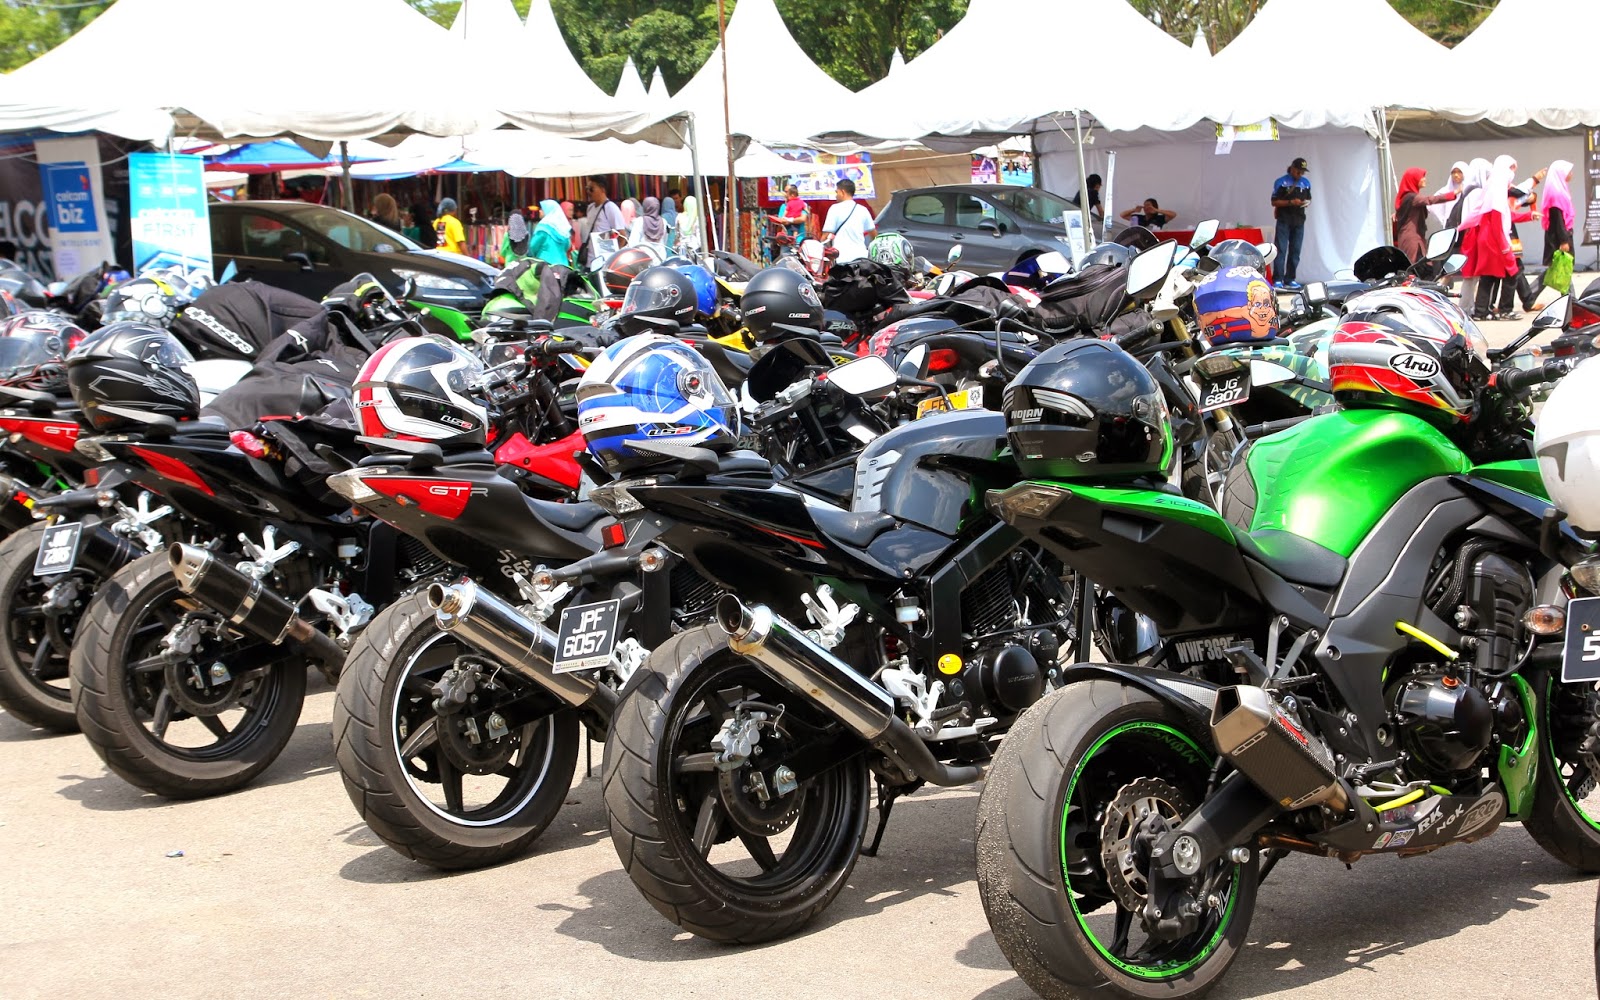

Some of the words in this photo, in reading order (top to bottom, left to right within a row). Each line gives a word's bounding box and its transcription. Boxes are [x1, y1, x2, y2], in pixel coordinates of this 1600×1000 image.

[58, 204, 85, 225] biz
[143, 222, 198, 237] FIRST
[184, 306, 254, 354] alpinestars
[1393, 355, 1434, 373] Arai
[1211, 378, 1238, 394] AJG
[1205, 387, 1243, 406] 6807
[440, 414, 473, 430] LS2
[1011, 408, 1044, 423] NOLAN
[646, 426, 692, 437] LS2
[429, 485, 489, 498] GTR
[572, 607, 606, 634] JPF
[562, 629, 608, 658] 6057
[1418, 805, 1443, 833] RK
[1436, 804, 1464, 835] NGK
